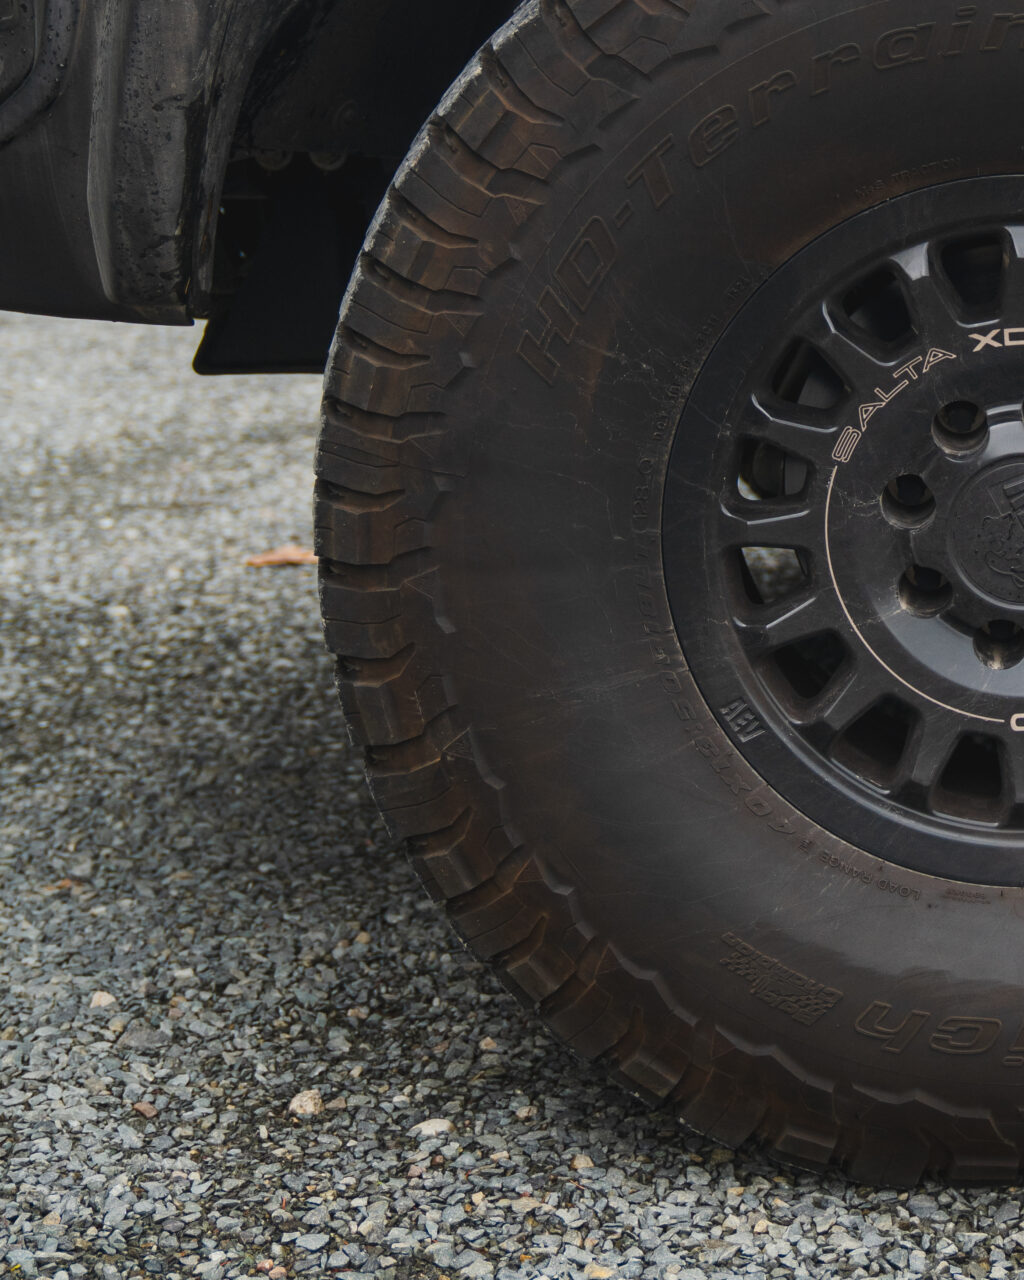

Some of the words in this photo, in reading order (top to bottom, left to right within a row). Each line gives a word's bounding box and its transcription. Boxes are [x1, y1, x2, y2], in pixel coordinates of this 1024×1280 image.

[831, 347, 957, 463] SALTA
[719, 697, 767, 743] AEV
[817, 847, 875, 887] RANGE
[874, 875, 921, 903] LOAD
[719, 930, 845, 1007] Champion
